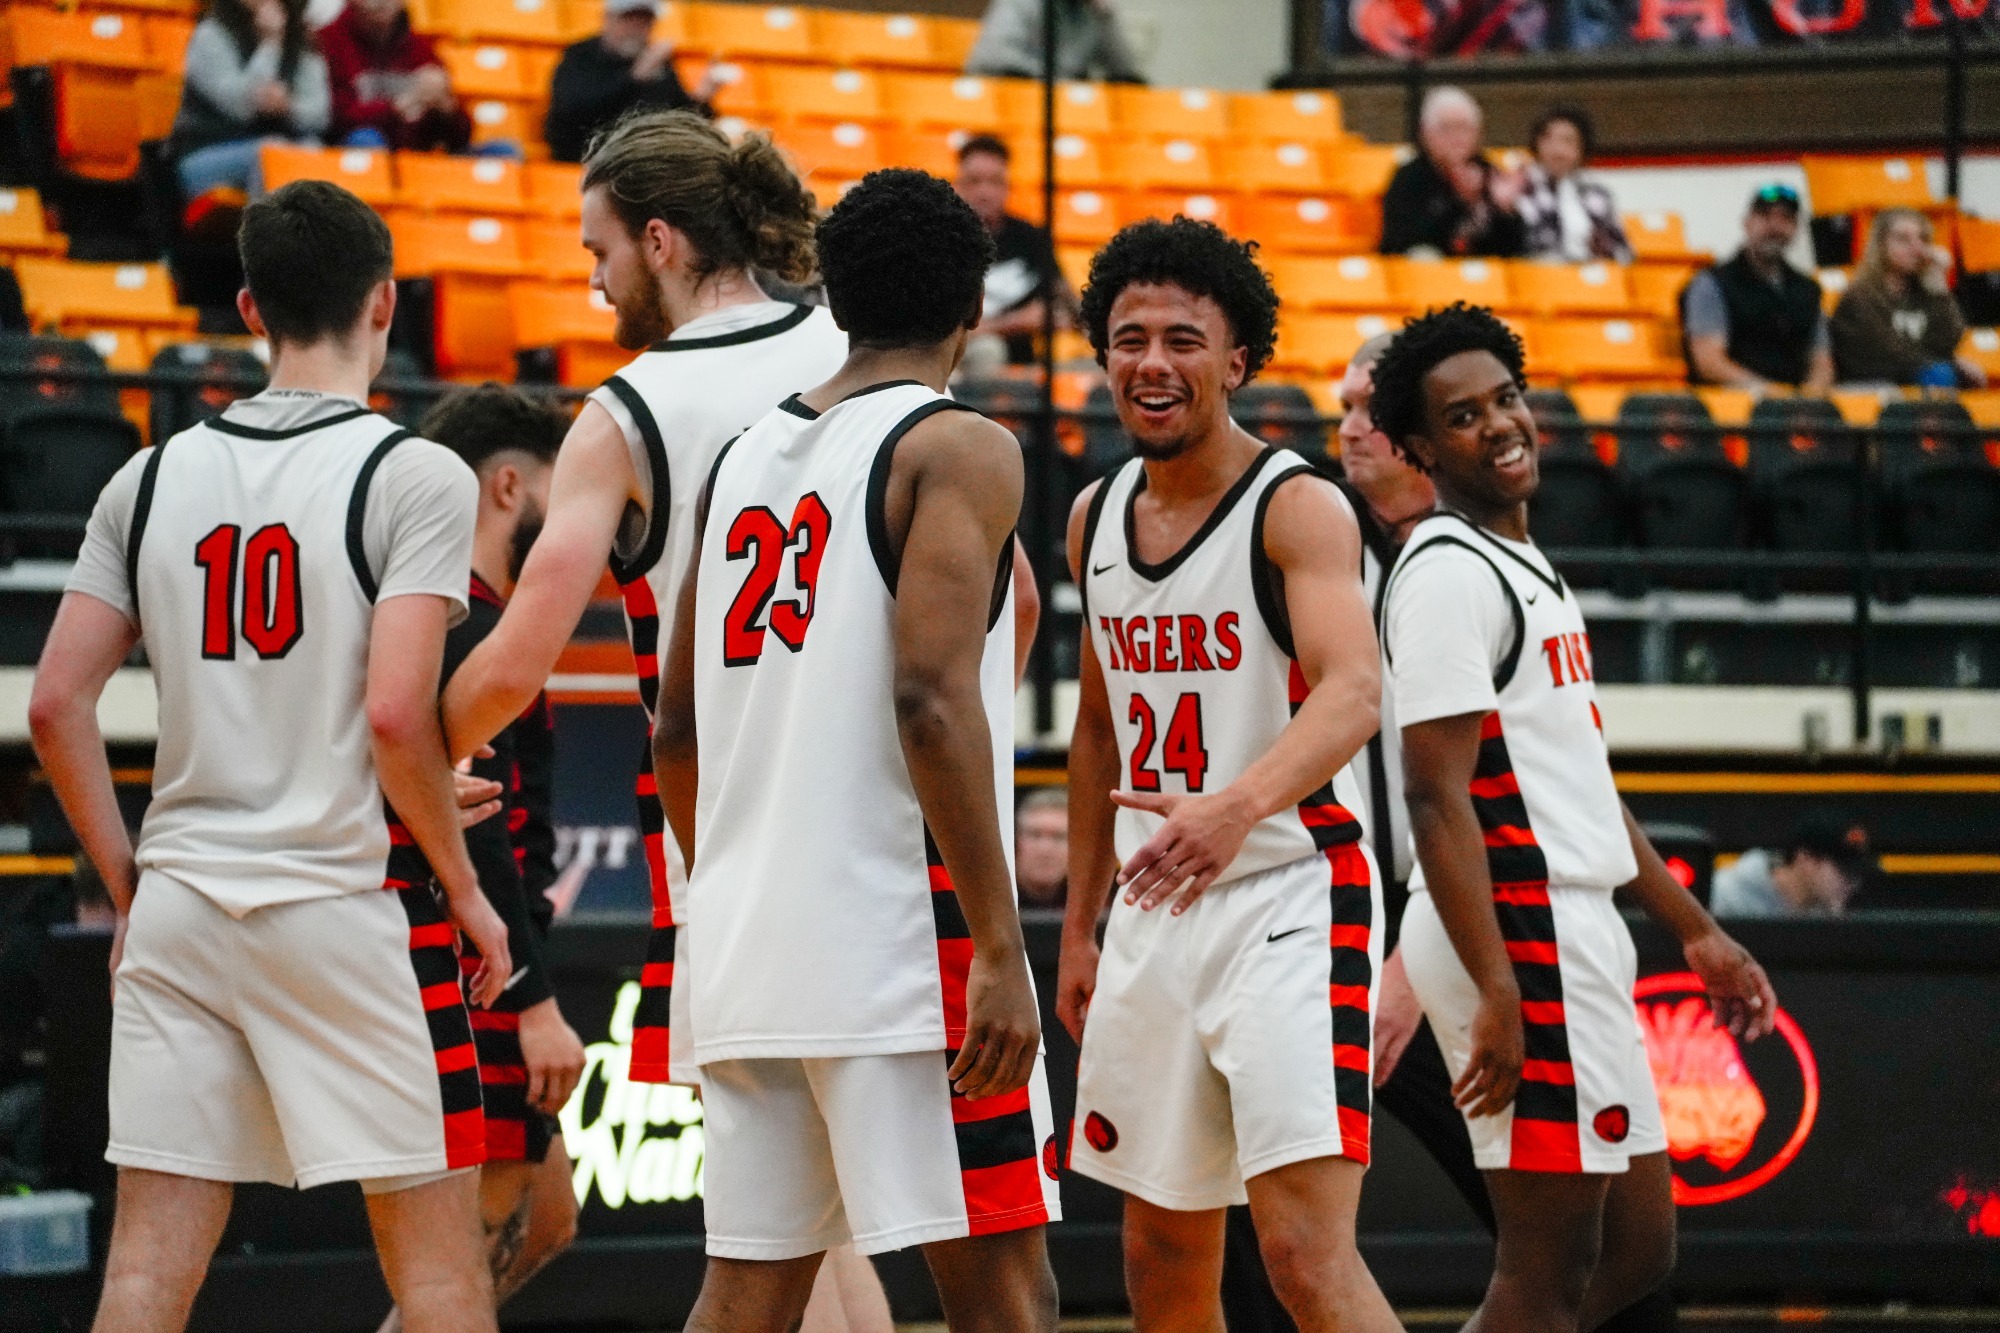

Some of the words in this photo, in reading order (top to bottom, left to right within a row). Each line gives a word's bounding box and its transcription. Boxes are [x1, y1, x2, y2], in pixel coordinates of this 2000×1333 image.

[195, 522, 304, 661] 10
[723, 490, 832, 668] 23
[1098, 611, 1242, 673] TIGERS
[1129, 692, 1208, 792] 24
[572, 1121, 704, 1210] Nat
